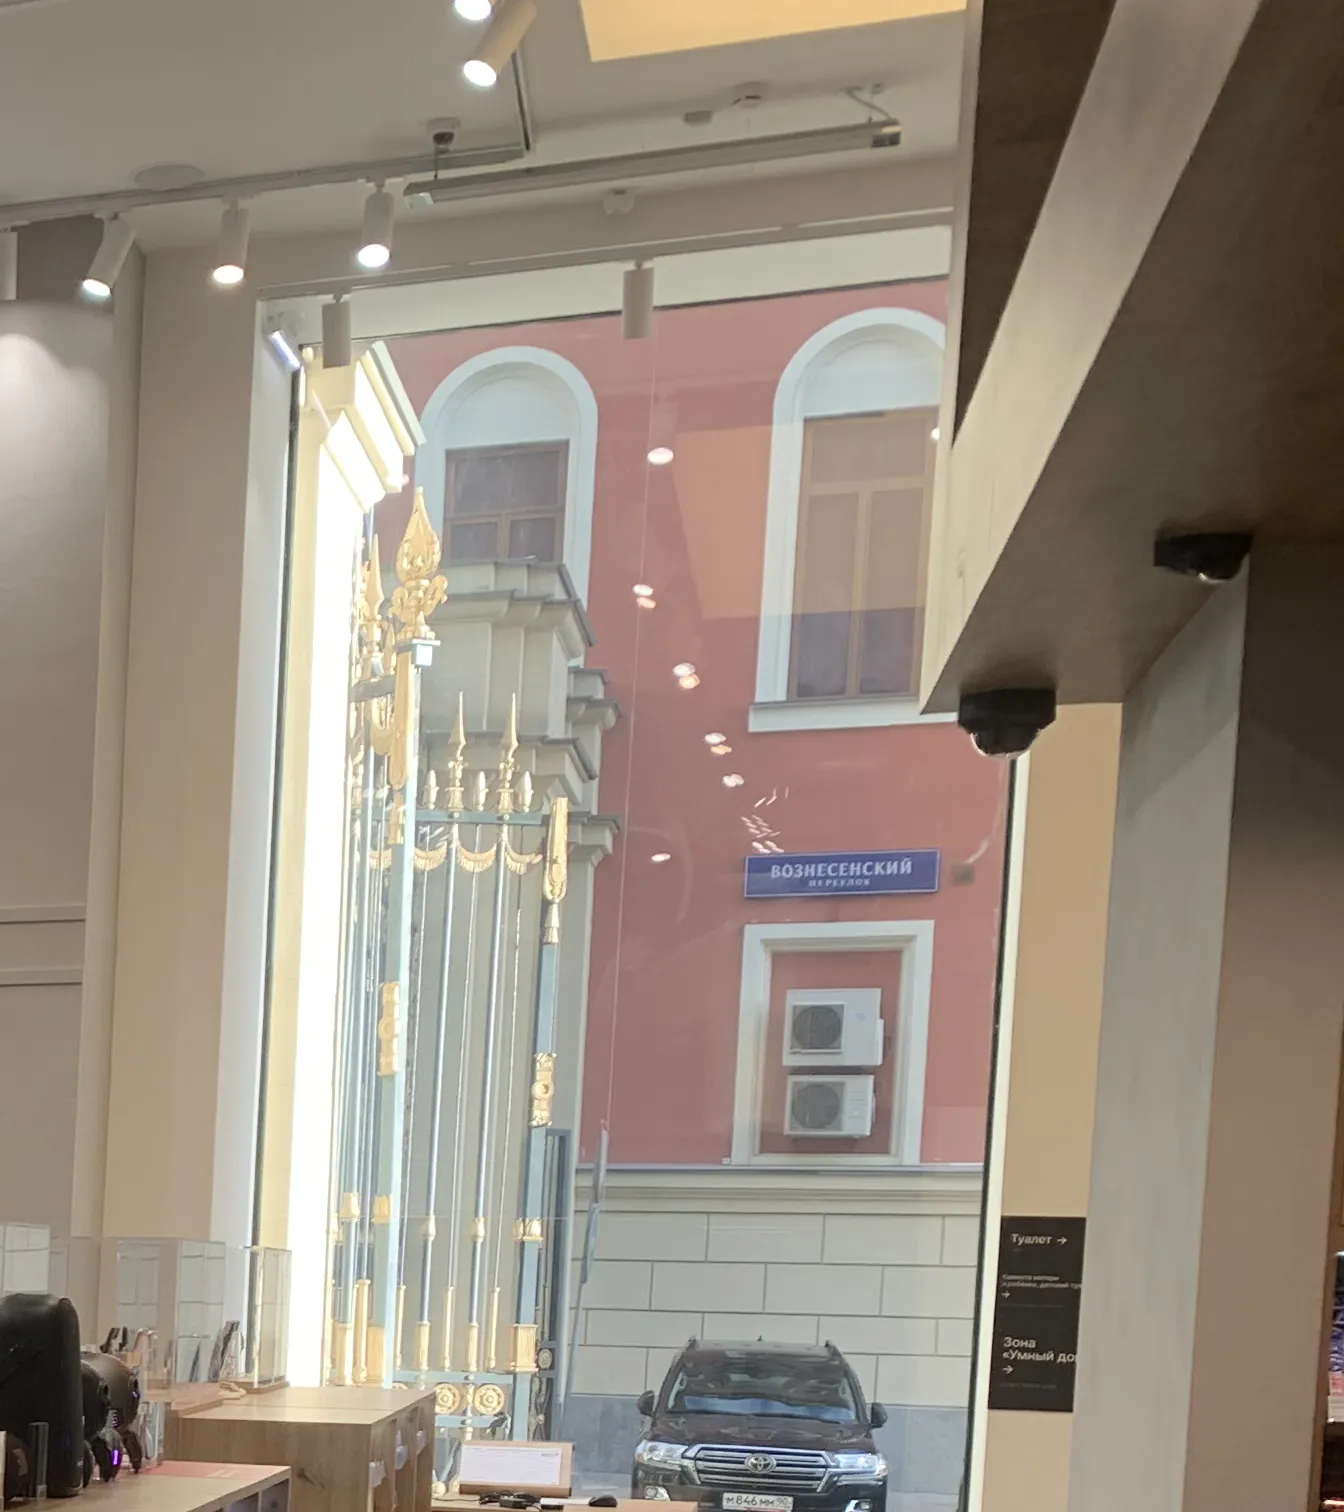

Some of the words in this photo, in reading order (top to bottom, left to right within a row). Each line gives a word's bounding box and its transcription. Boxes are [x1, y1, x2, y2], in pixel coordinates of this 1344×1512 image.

[771, 857, 913, 879] ВОЗНЕСЕНСКИЙ
[808, 877, 871, 888] ПЕРЕУЛОК
[1011, 1233, 1052, 1246] Туалет
[1004, 1336, 1037, 1349] Зона
[1002, 1348, 1054, 1361] «Умный
